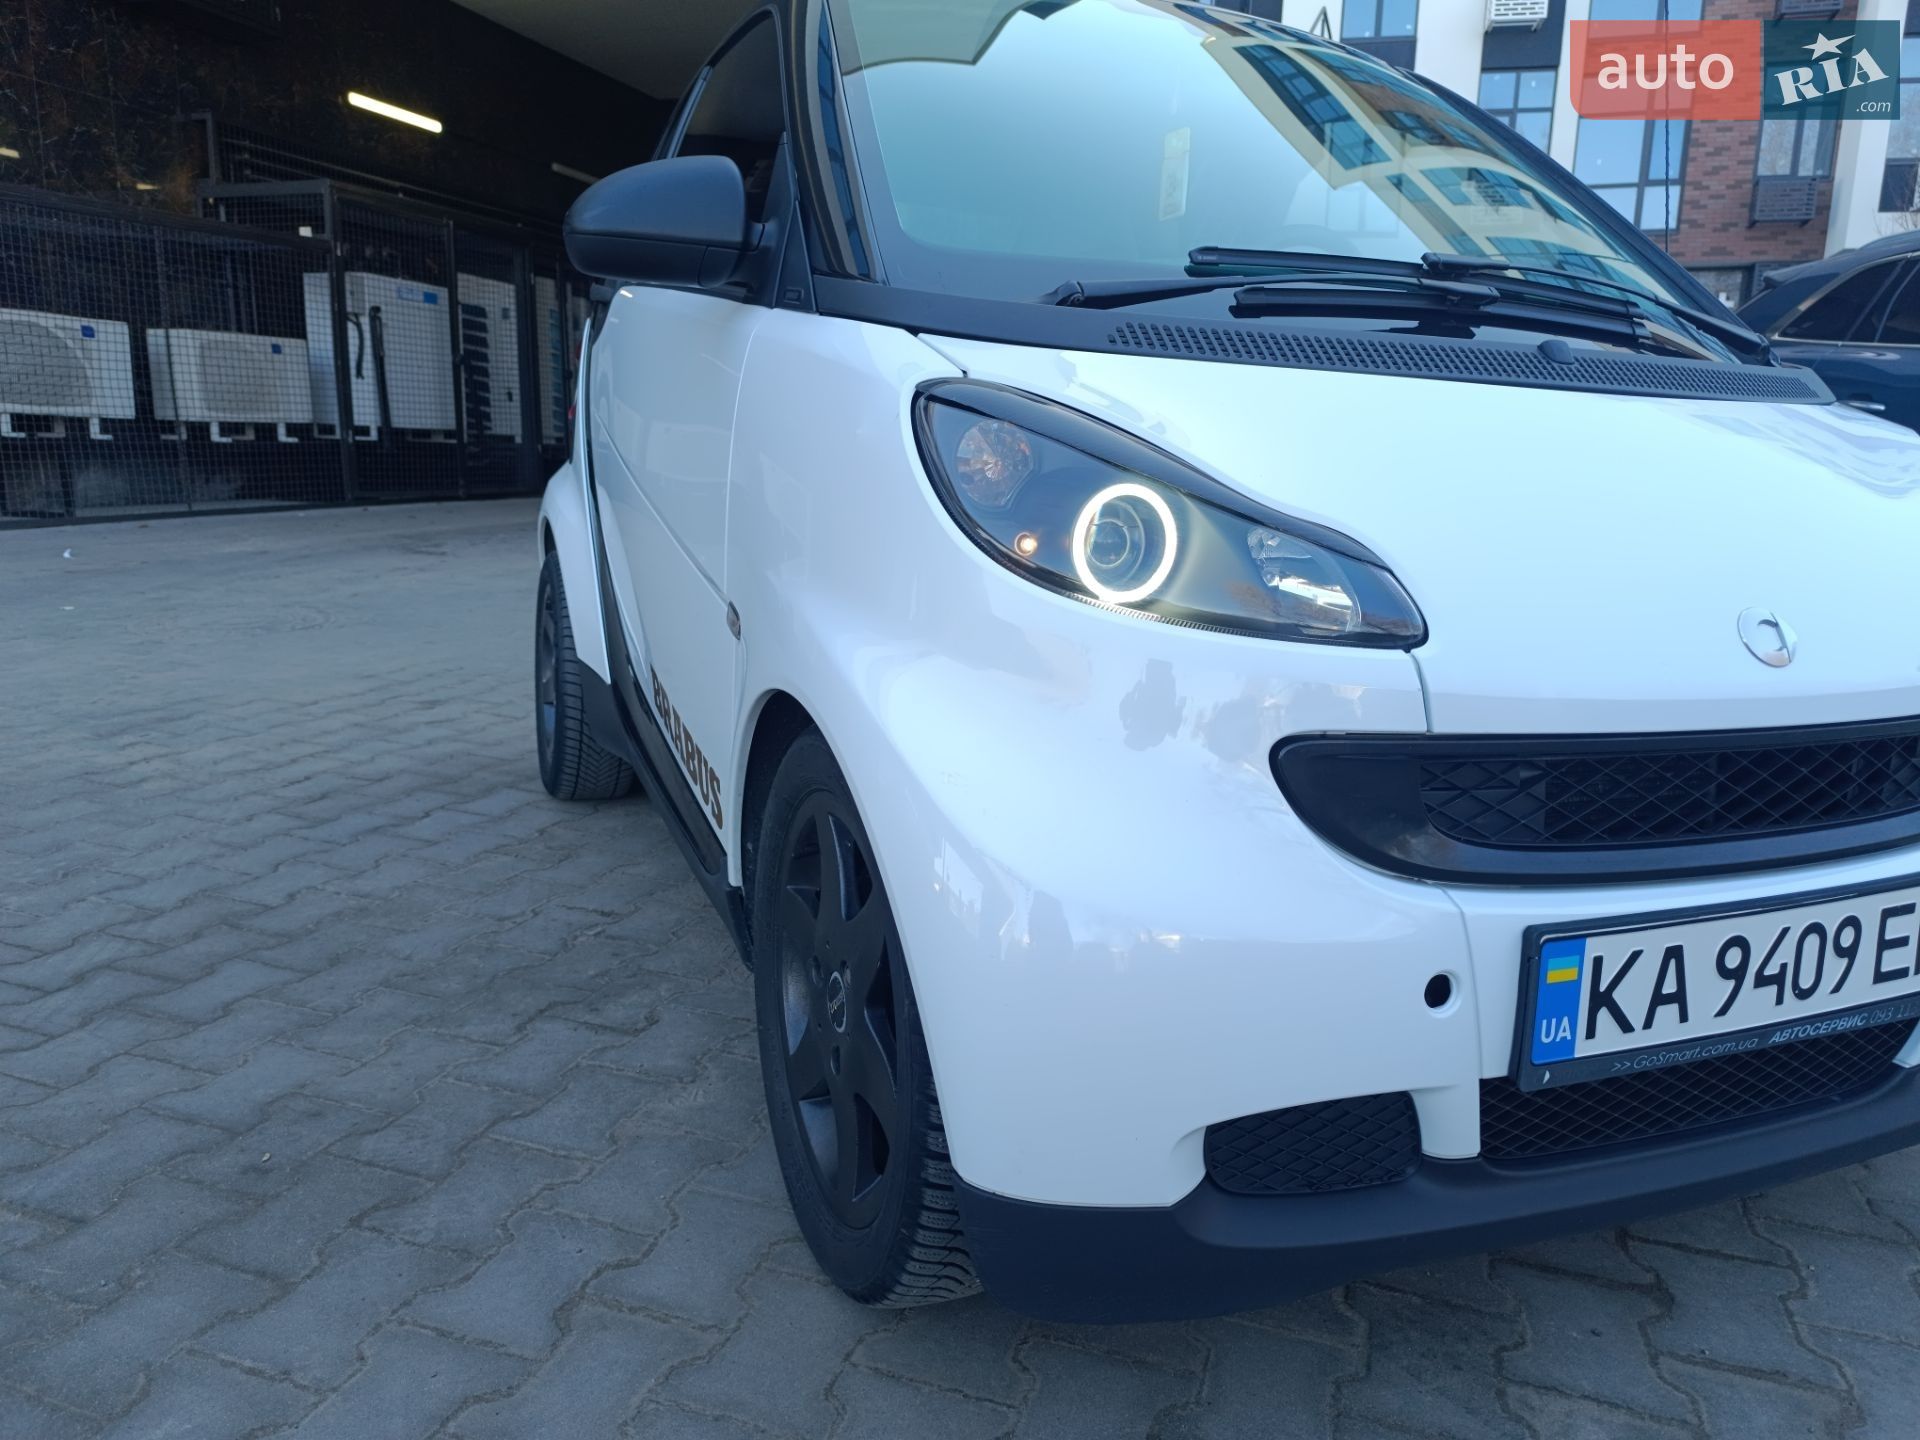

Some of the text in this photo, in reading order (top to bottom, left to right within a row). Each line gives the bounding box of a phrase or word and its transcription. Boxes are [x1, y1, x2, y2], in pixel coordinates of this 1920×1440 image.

[650, 663, 723, 830] BRABUS
[1584, 944, 1689, 1040] KA
[1713, 914, 1863, 1018] 9409
[1540, 1014, 1572, 1044] UA
[1768, 1012, 1869, 1044] АВТОСЕРВИС
